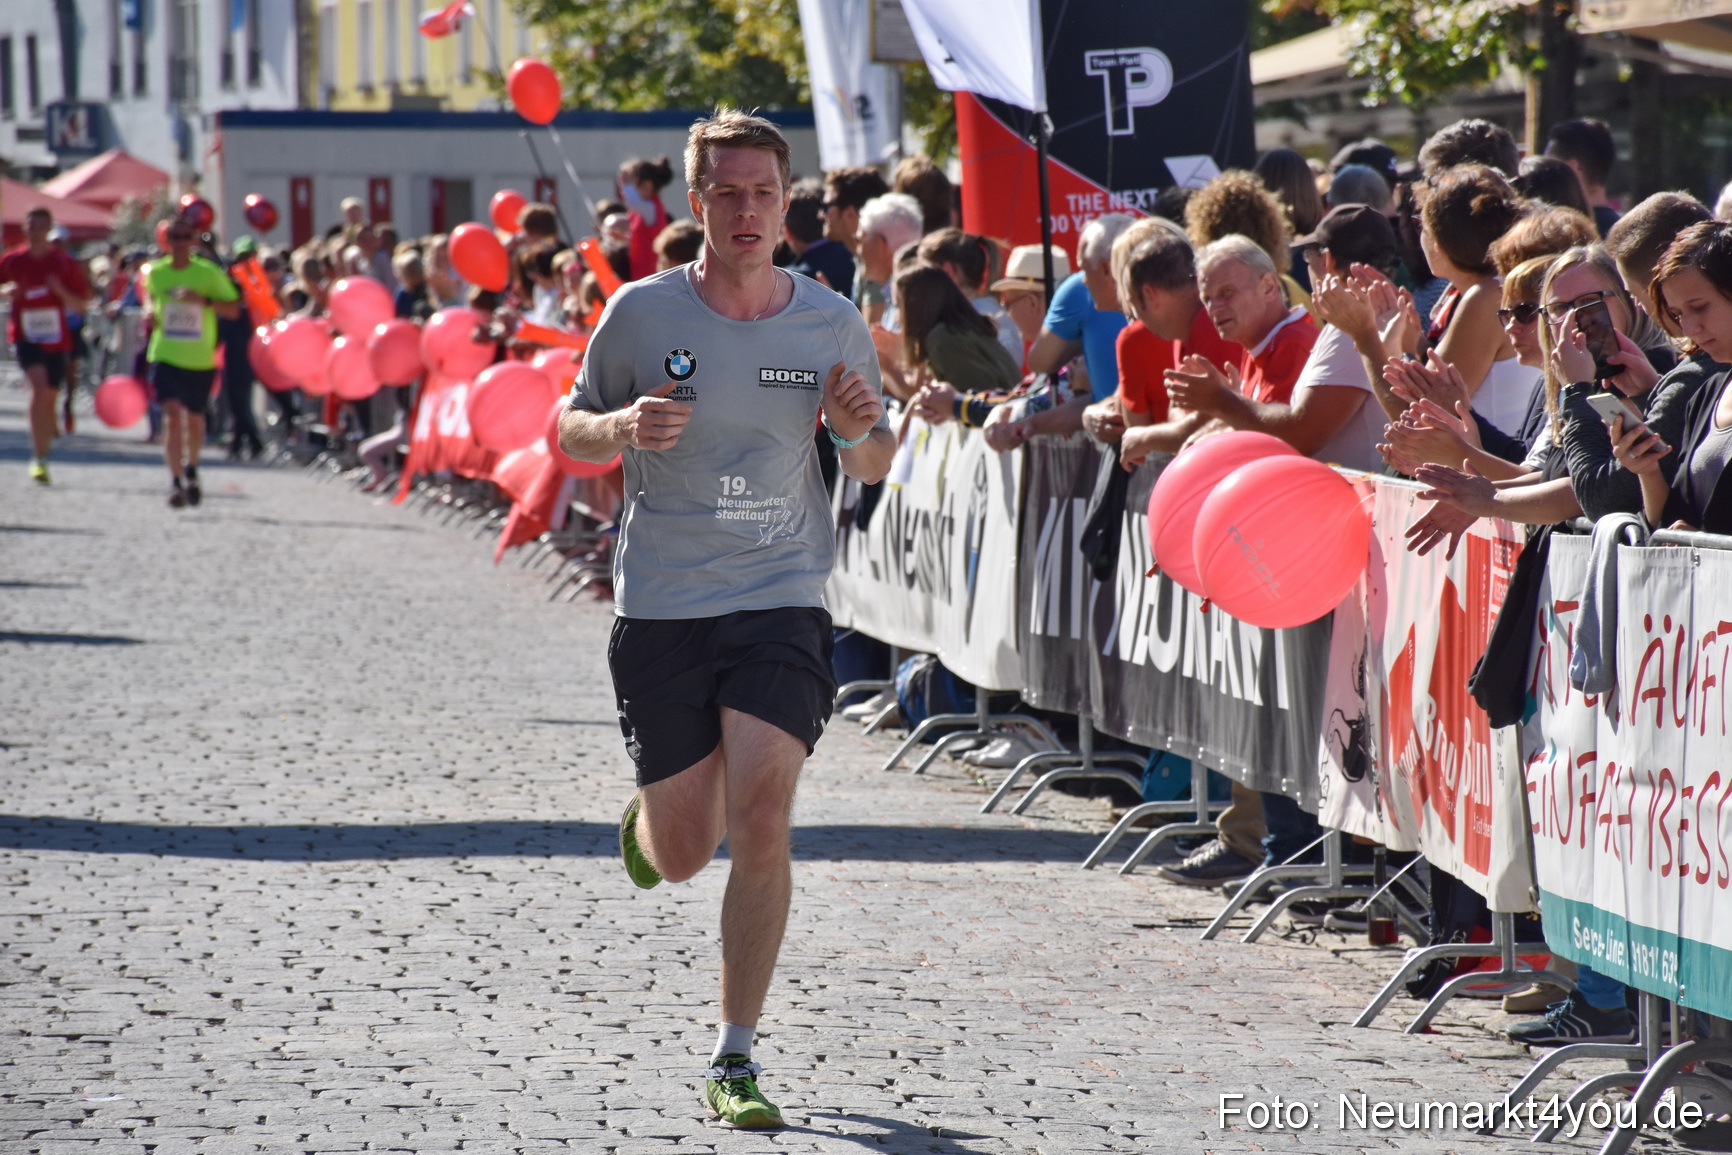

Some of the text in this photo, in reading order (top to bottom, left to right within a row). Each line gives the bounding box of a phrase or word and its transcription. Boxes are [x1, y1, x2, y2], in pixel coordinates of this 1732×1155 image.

[1065, 188, 1159, 213] THE NEXT
[1037, 213, 1069, 234] 00
[667, 349, 695, 361] BMW
[760, 368, 818, 385] BOCK
[668, 386, 698, 395] ARTL
[719, 475, 753, 496] 19.
[717, 497, 786, 509] Neumarkter
[715, 509, 771, 523] Stadtlauf
